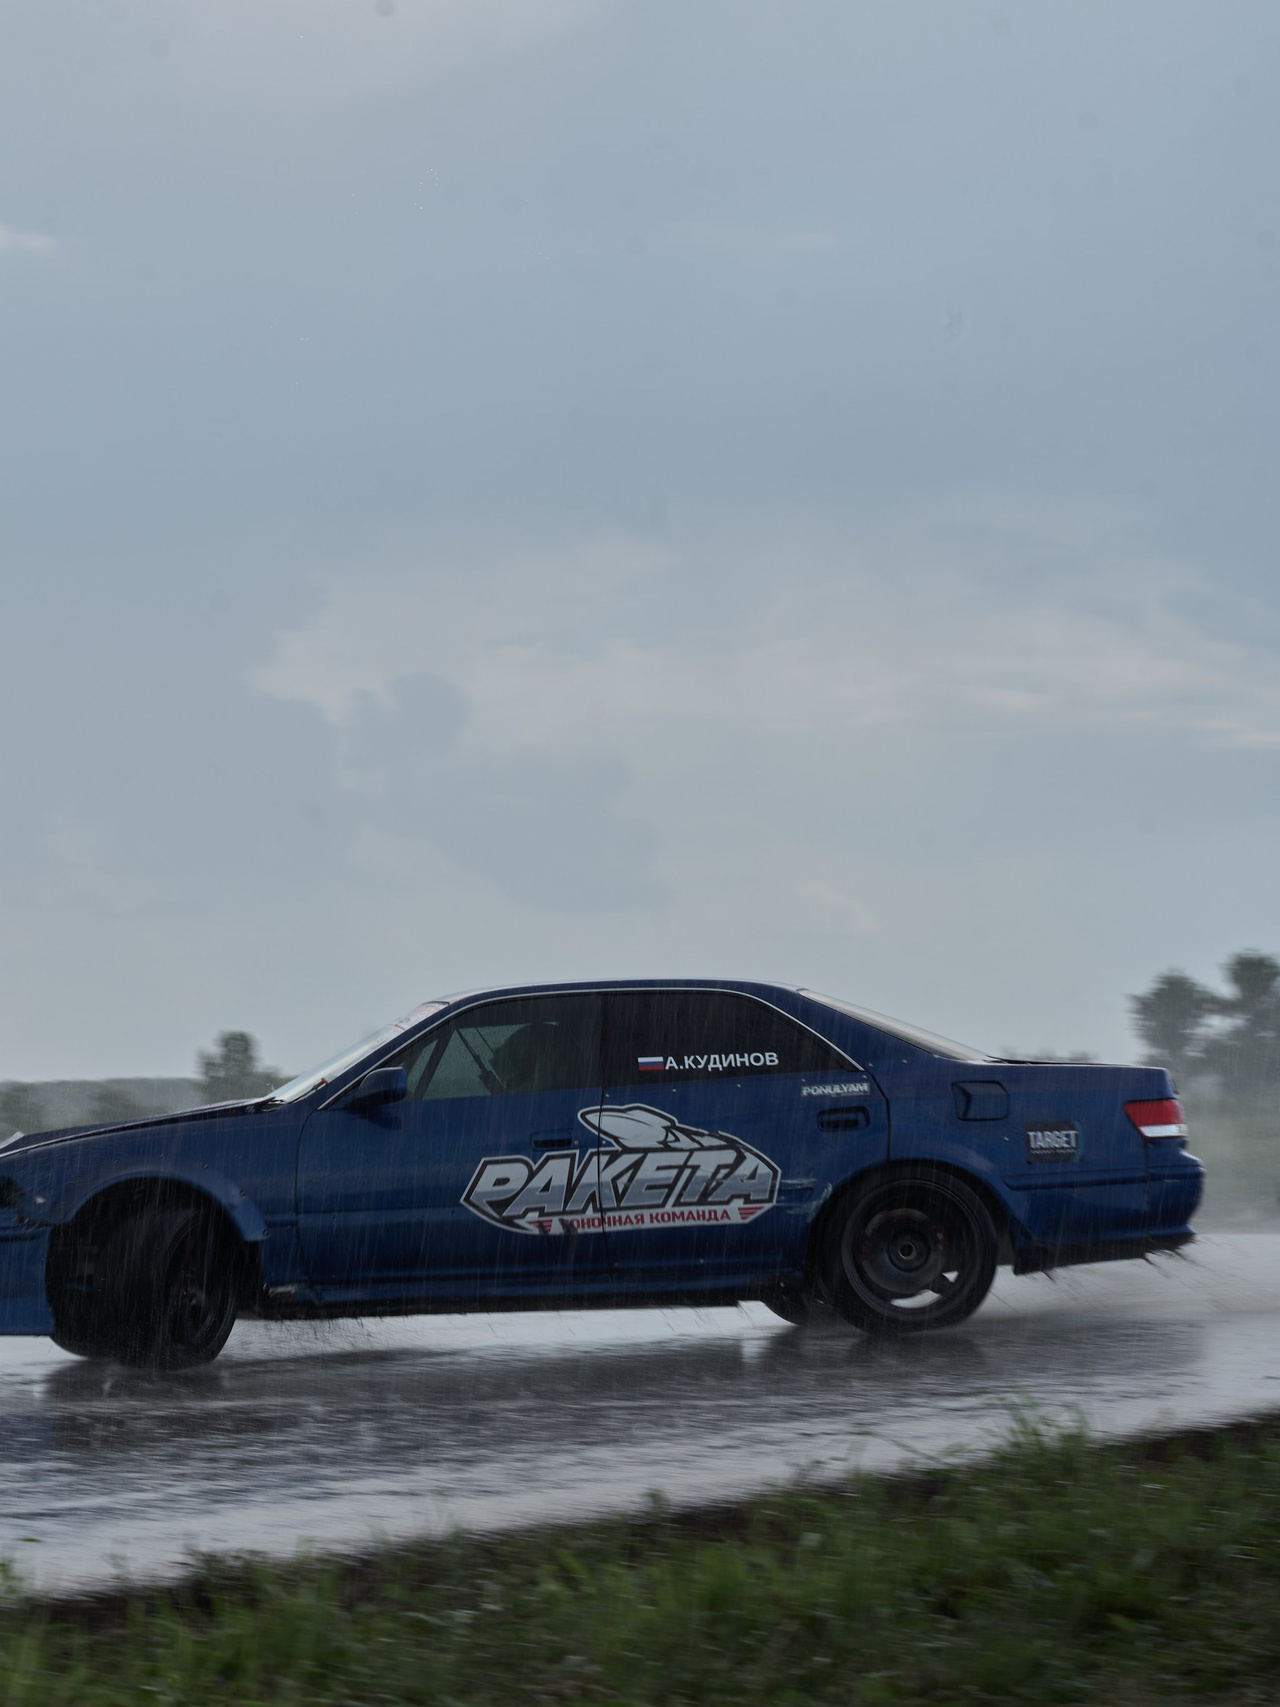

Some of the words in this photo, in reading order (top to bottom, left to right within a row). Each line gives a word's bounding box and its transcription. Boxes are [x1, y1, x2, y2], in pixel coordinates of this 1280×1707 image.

[665, 1052, 779, 1071] А.КУДИНОВ
[1027, 1130, 1078, 1149] TARGET
[469, 1149, 773, 1216] РАКЕТА
[561, 1211, 645, 1231] ОНОЧНАЯ
[650, 1208, 732, 1224] КОМАНДА
